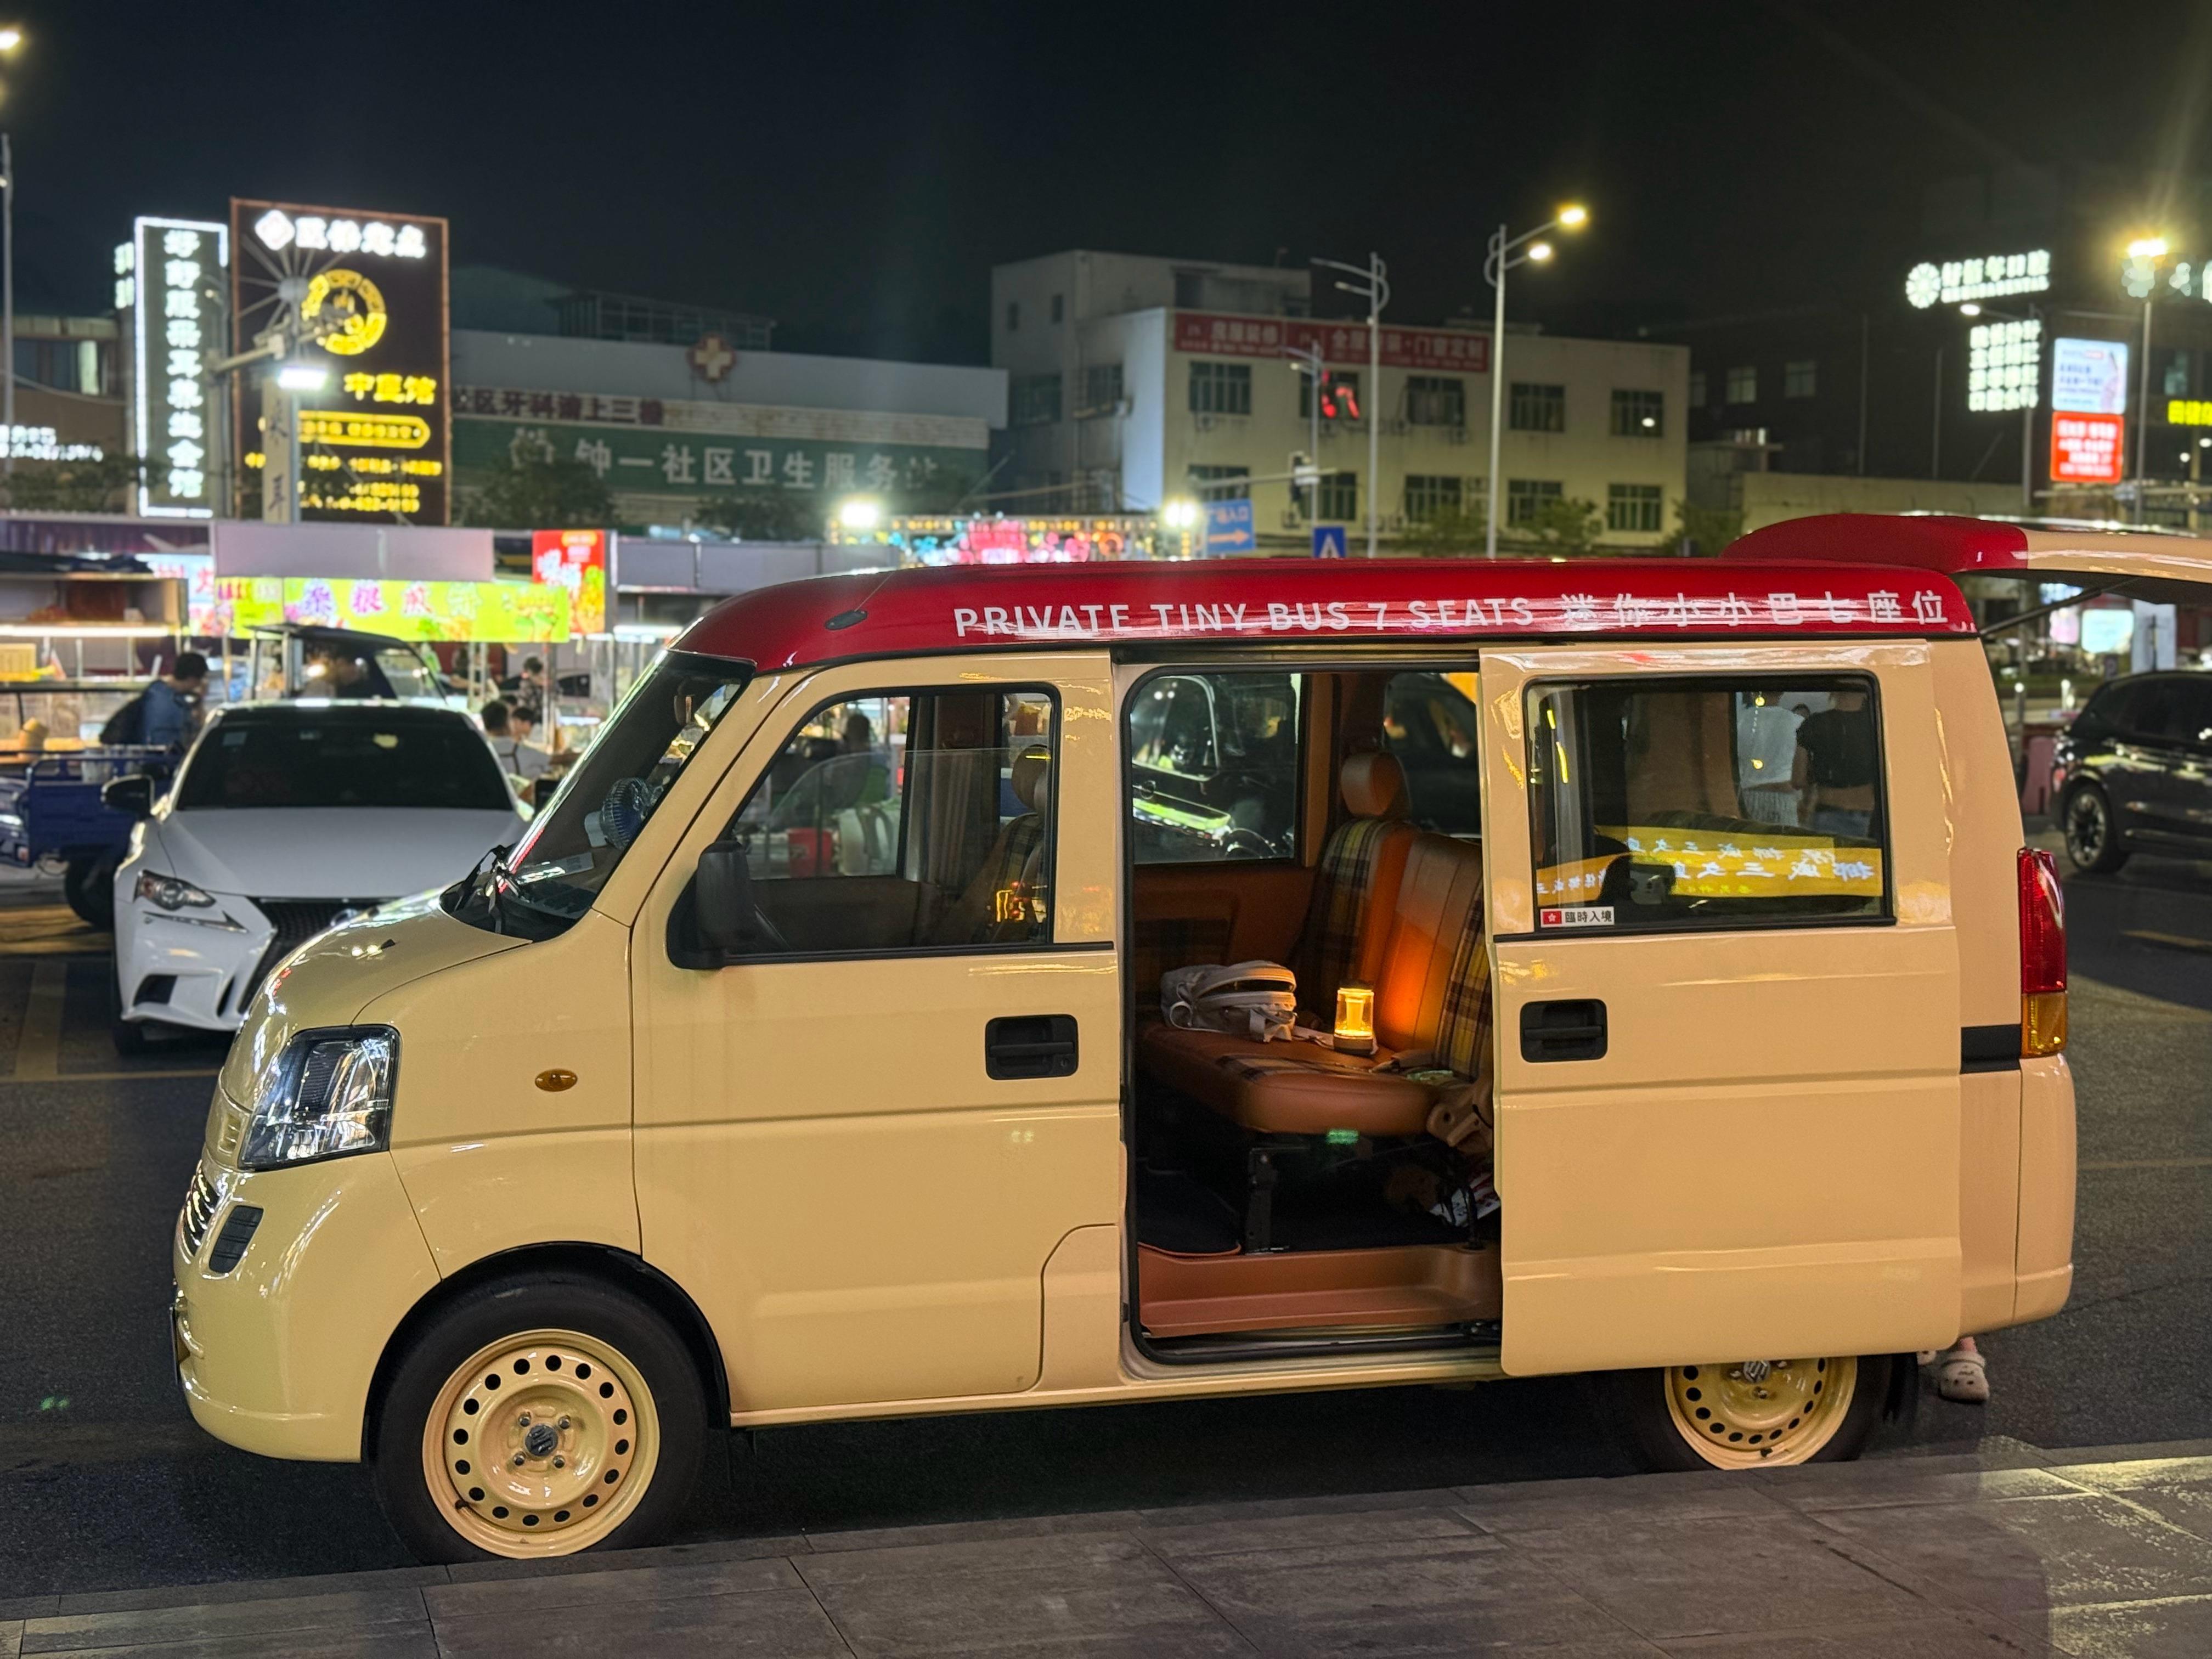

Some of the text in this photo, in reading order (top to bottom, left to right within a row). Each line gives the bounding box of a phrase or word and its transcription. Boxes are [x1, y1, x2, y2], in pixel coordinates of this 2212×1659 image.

[953, 597, 1534, 637] PRIVATE TINY BUS 7 SEATS
[1565, 910, 1612, 923] 臨時入境
